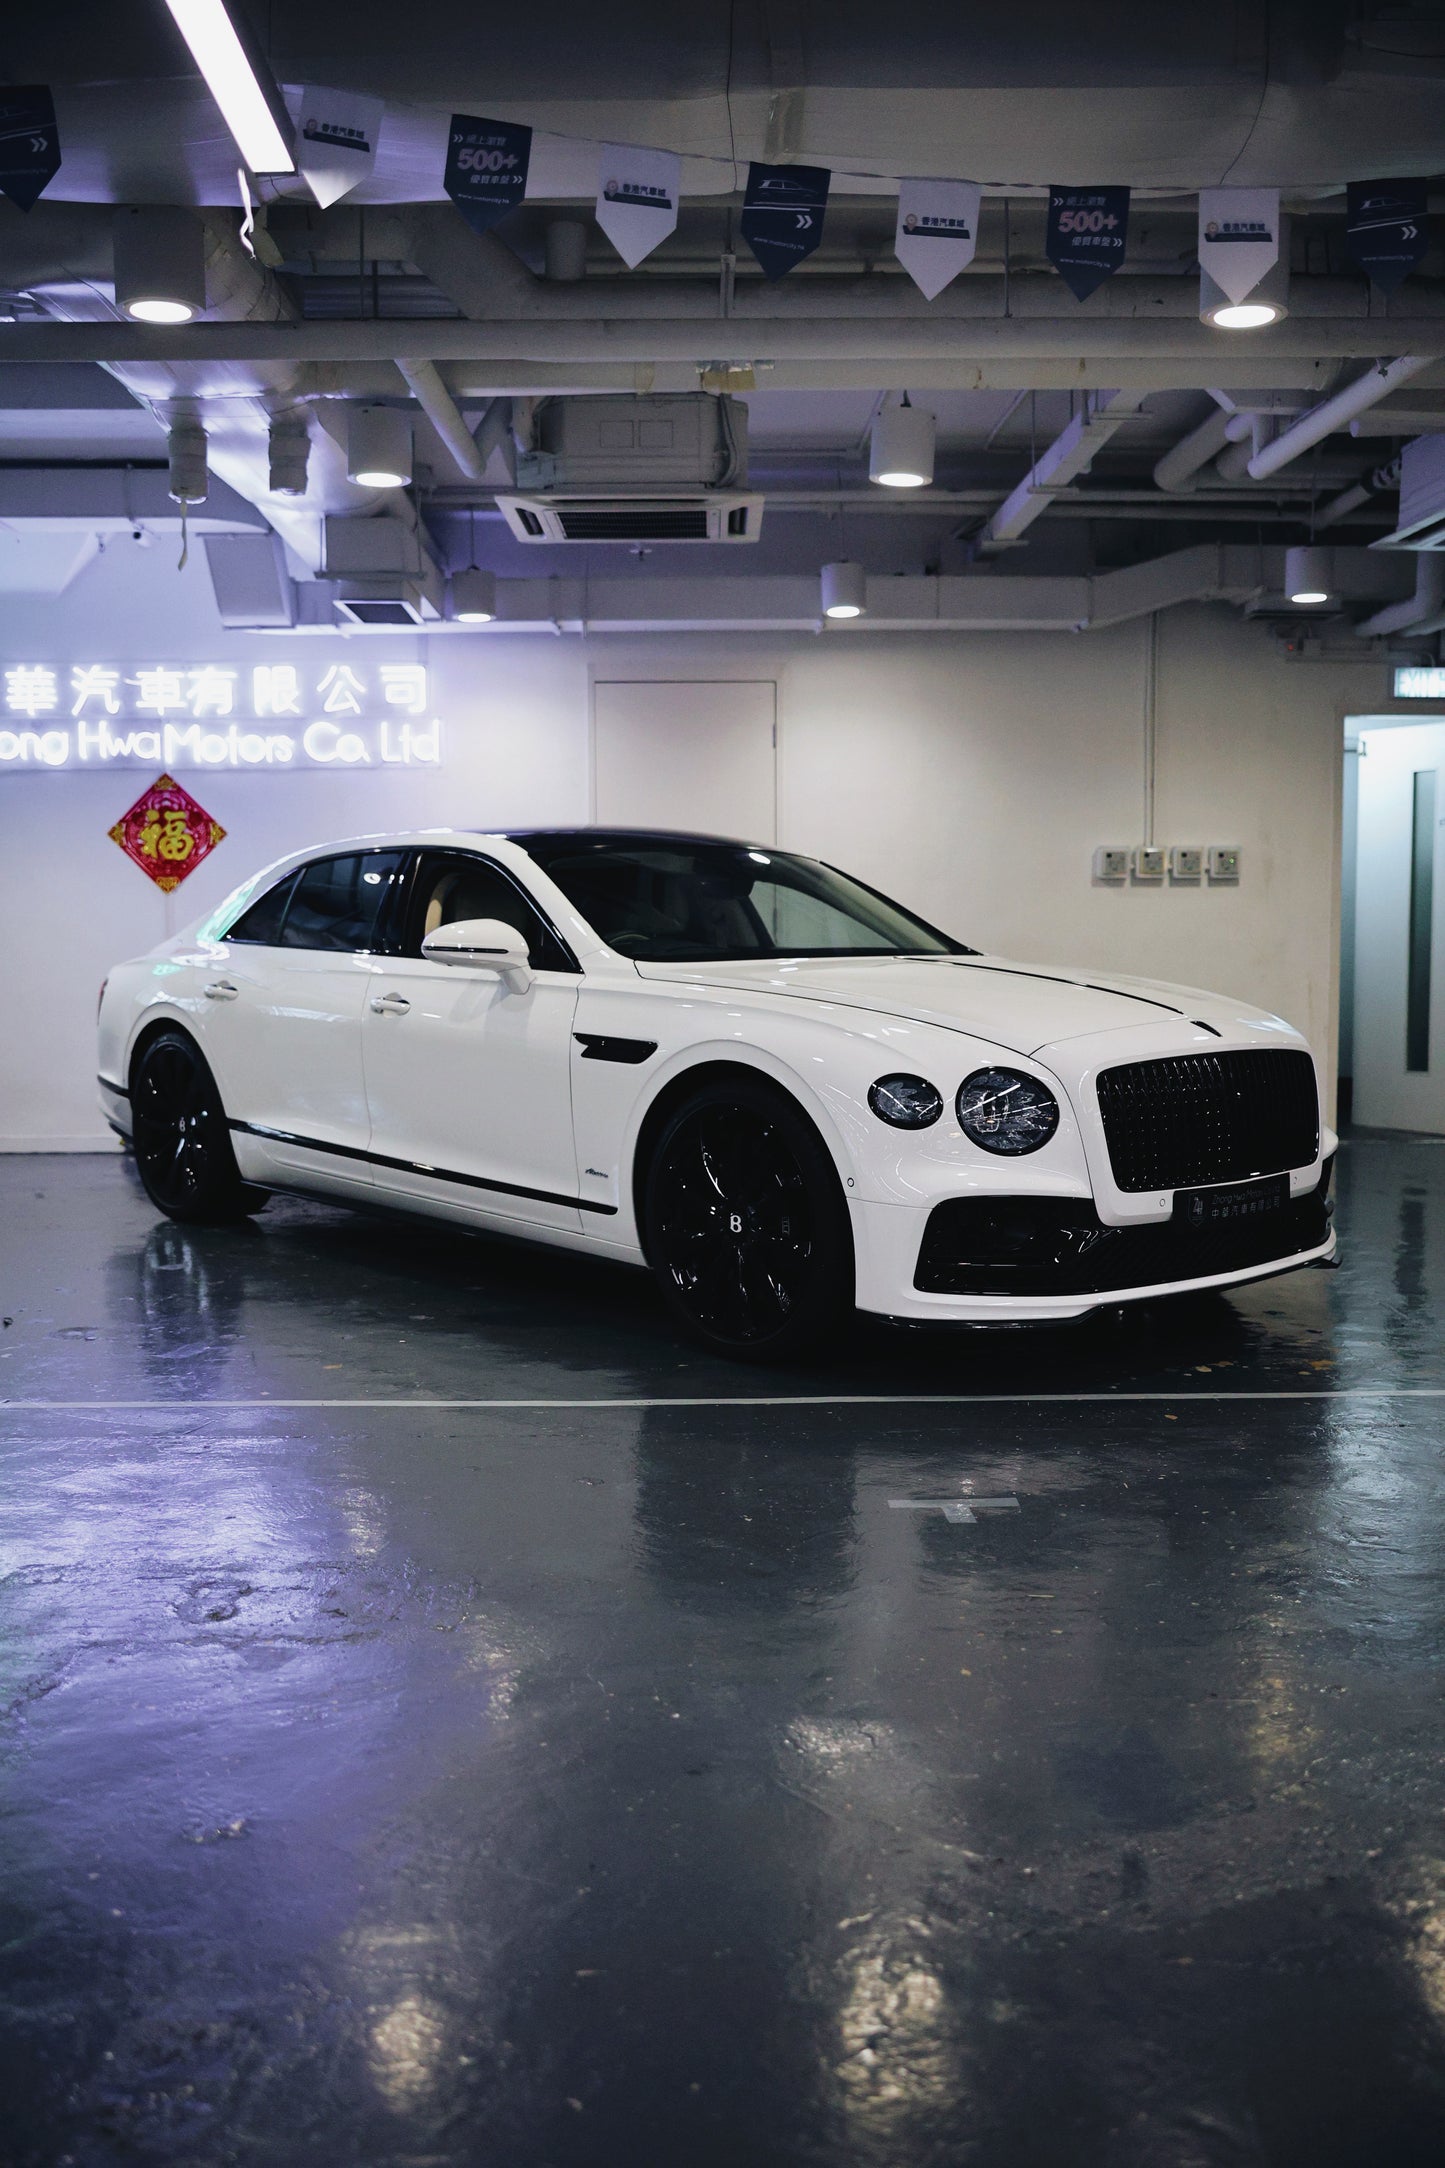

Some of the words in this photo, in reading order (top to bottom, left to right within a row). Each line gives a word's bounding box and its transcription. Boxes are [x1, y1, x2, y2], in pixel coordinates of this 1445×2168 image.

[457, 148, 519, 171] 500+
[1057, 210, 1119, 232] 500+
[4, 664, 427, 717] 華汽車有限公司
[78, 719, 161, 761] Hwa
[163, 722, 295, 765] Motors
[380, 717, 440, 764] Ltd
[139, 808, 195, 861] 福
